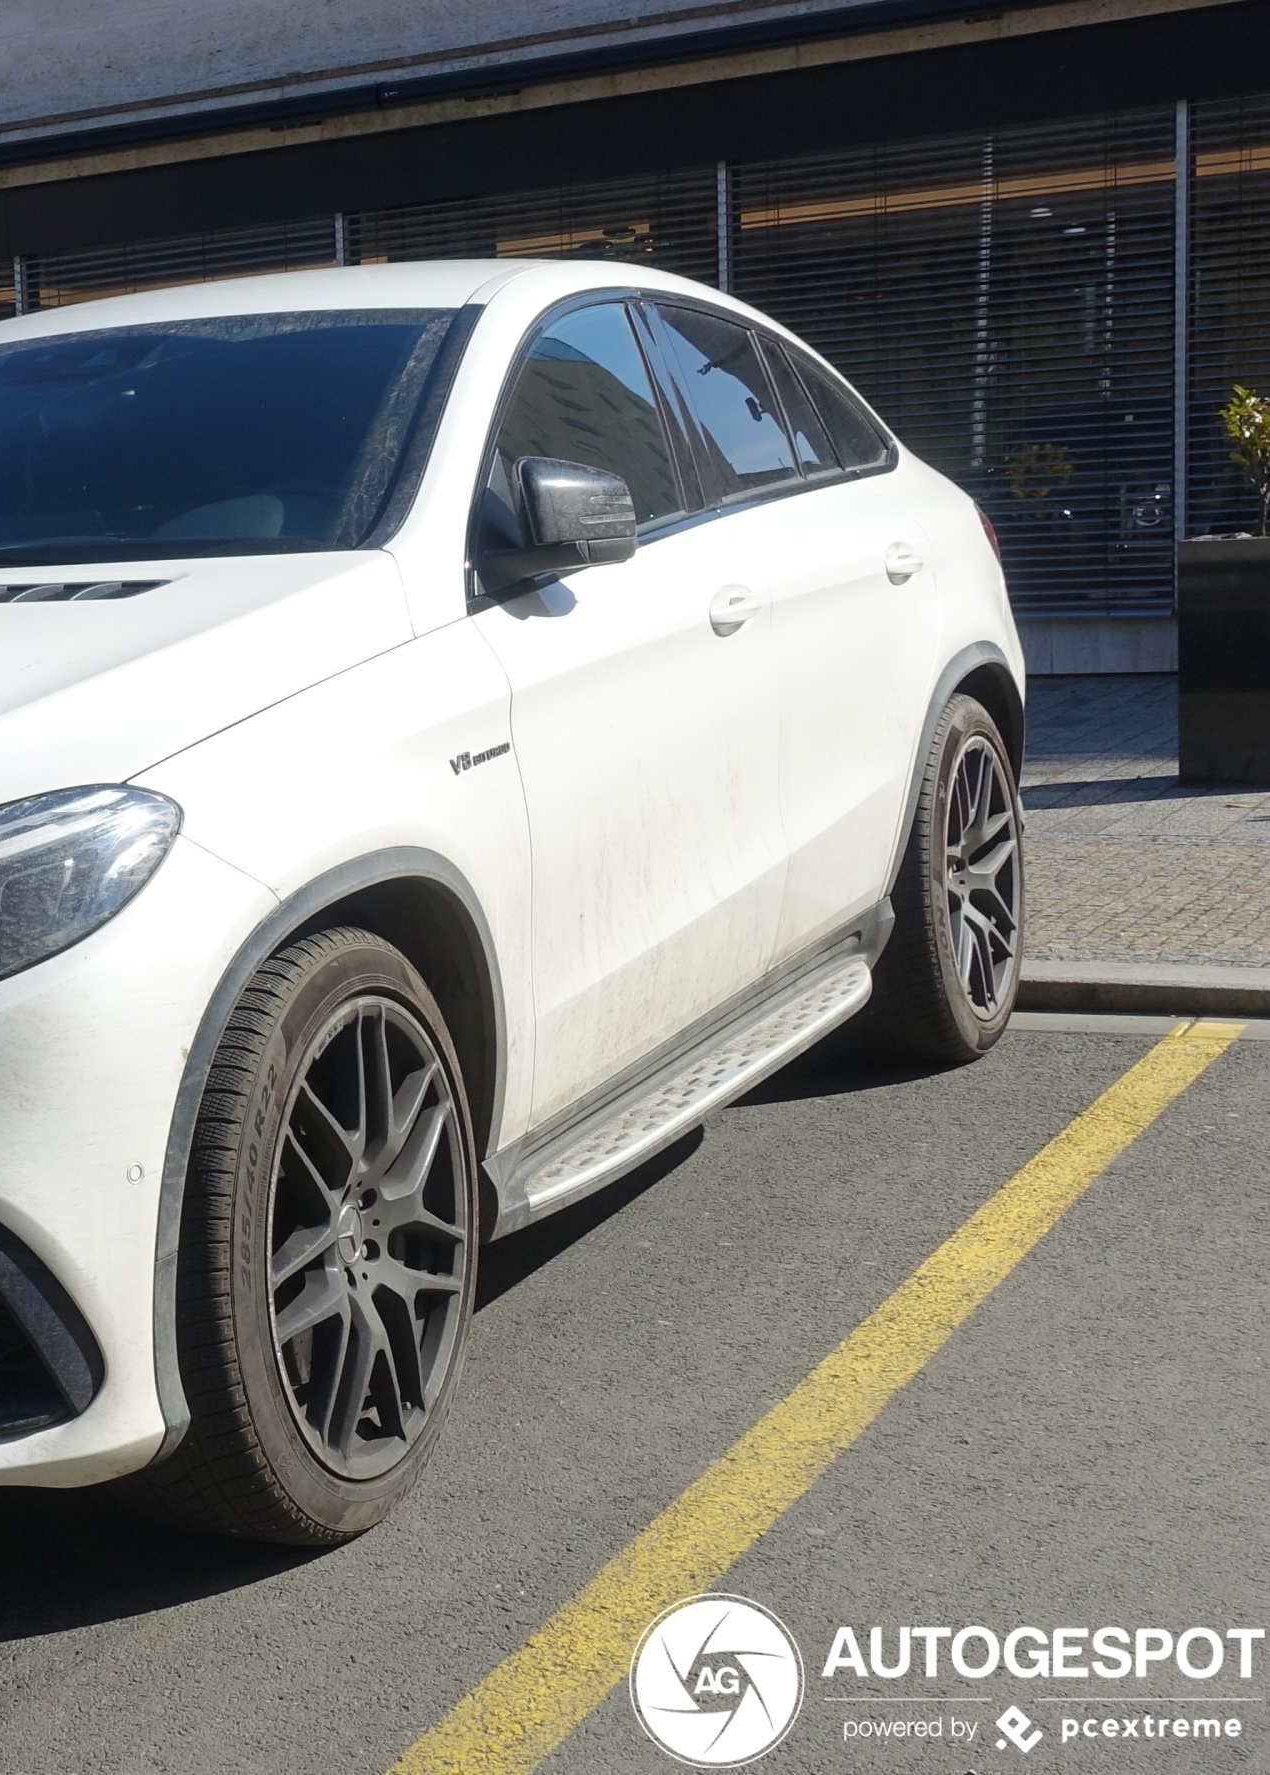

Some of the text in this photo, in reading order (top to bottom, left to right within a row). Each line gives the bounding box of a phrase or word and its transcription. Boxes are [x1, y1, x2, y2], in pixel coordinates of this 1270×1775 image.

[449, 751, 472, 776] V8
[241, 1142, 259, 1293] 285/40
[254, 1063, 277, 1137] R22
